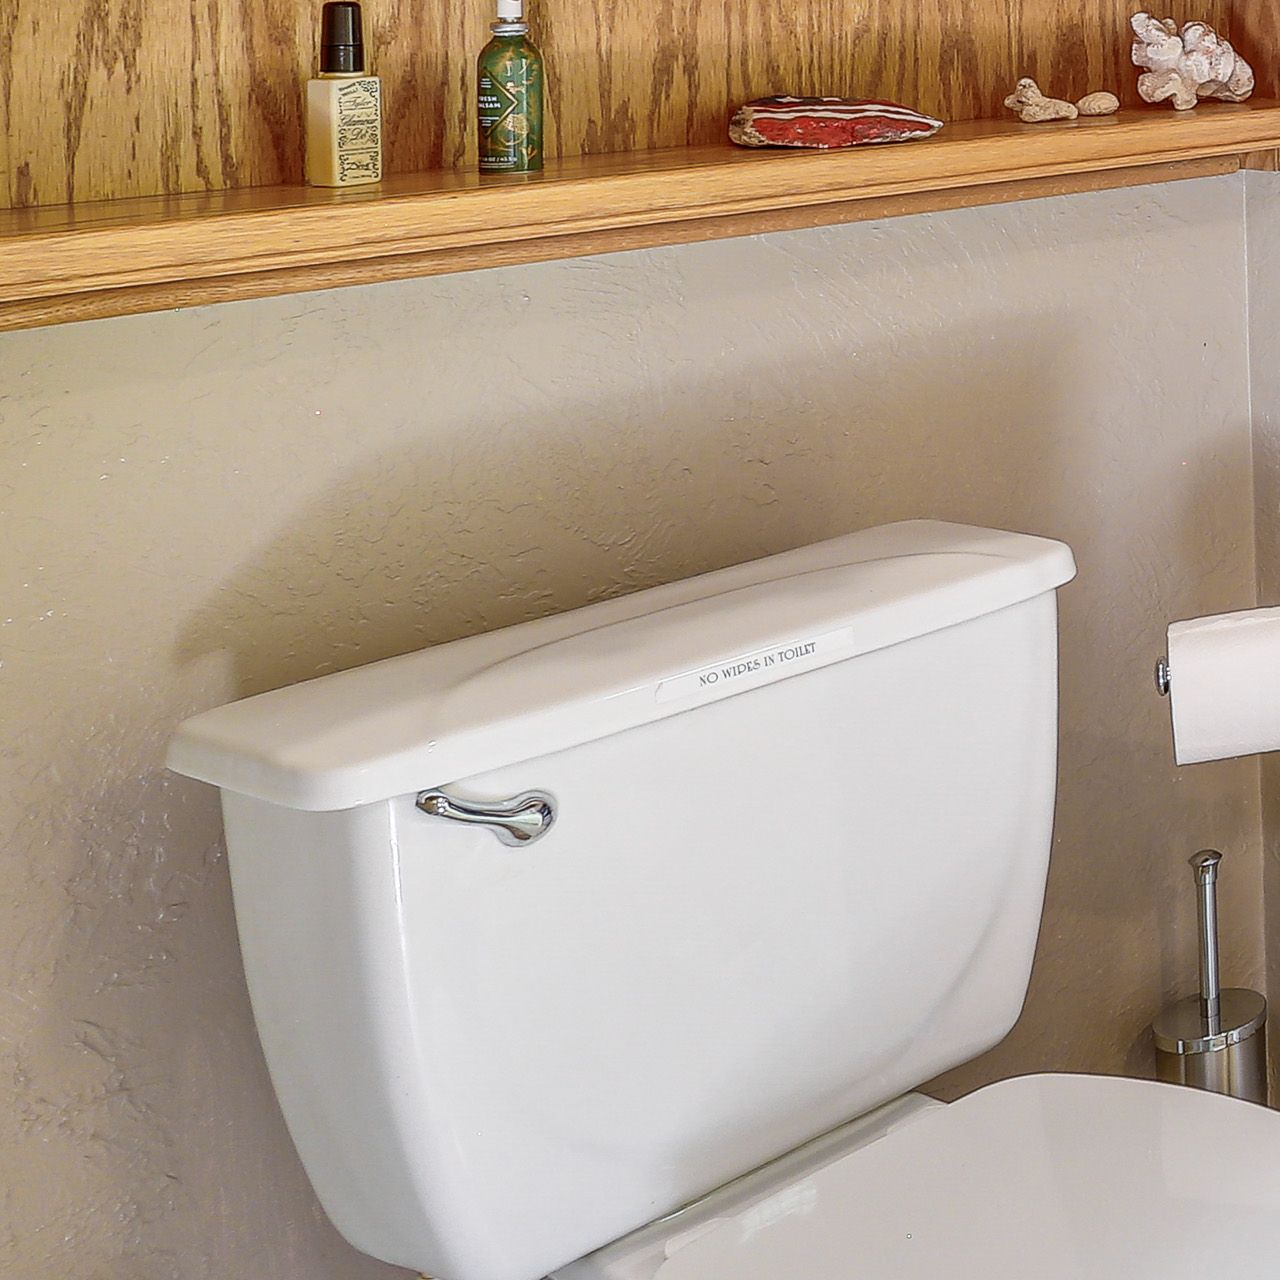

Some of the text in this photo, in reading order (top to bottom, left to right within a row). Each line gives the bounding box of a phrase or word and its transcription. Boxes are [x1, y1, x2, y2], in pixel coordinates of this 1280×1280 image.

[698, 641, 816, 687] NO WIPES IN TOILET
